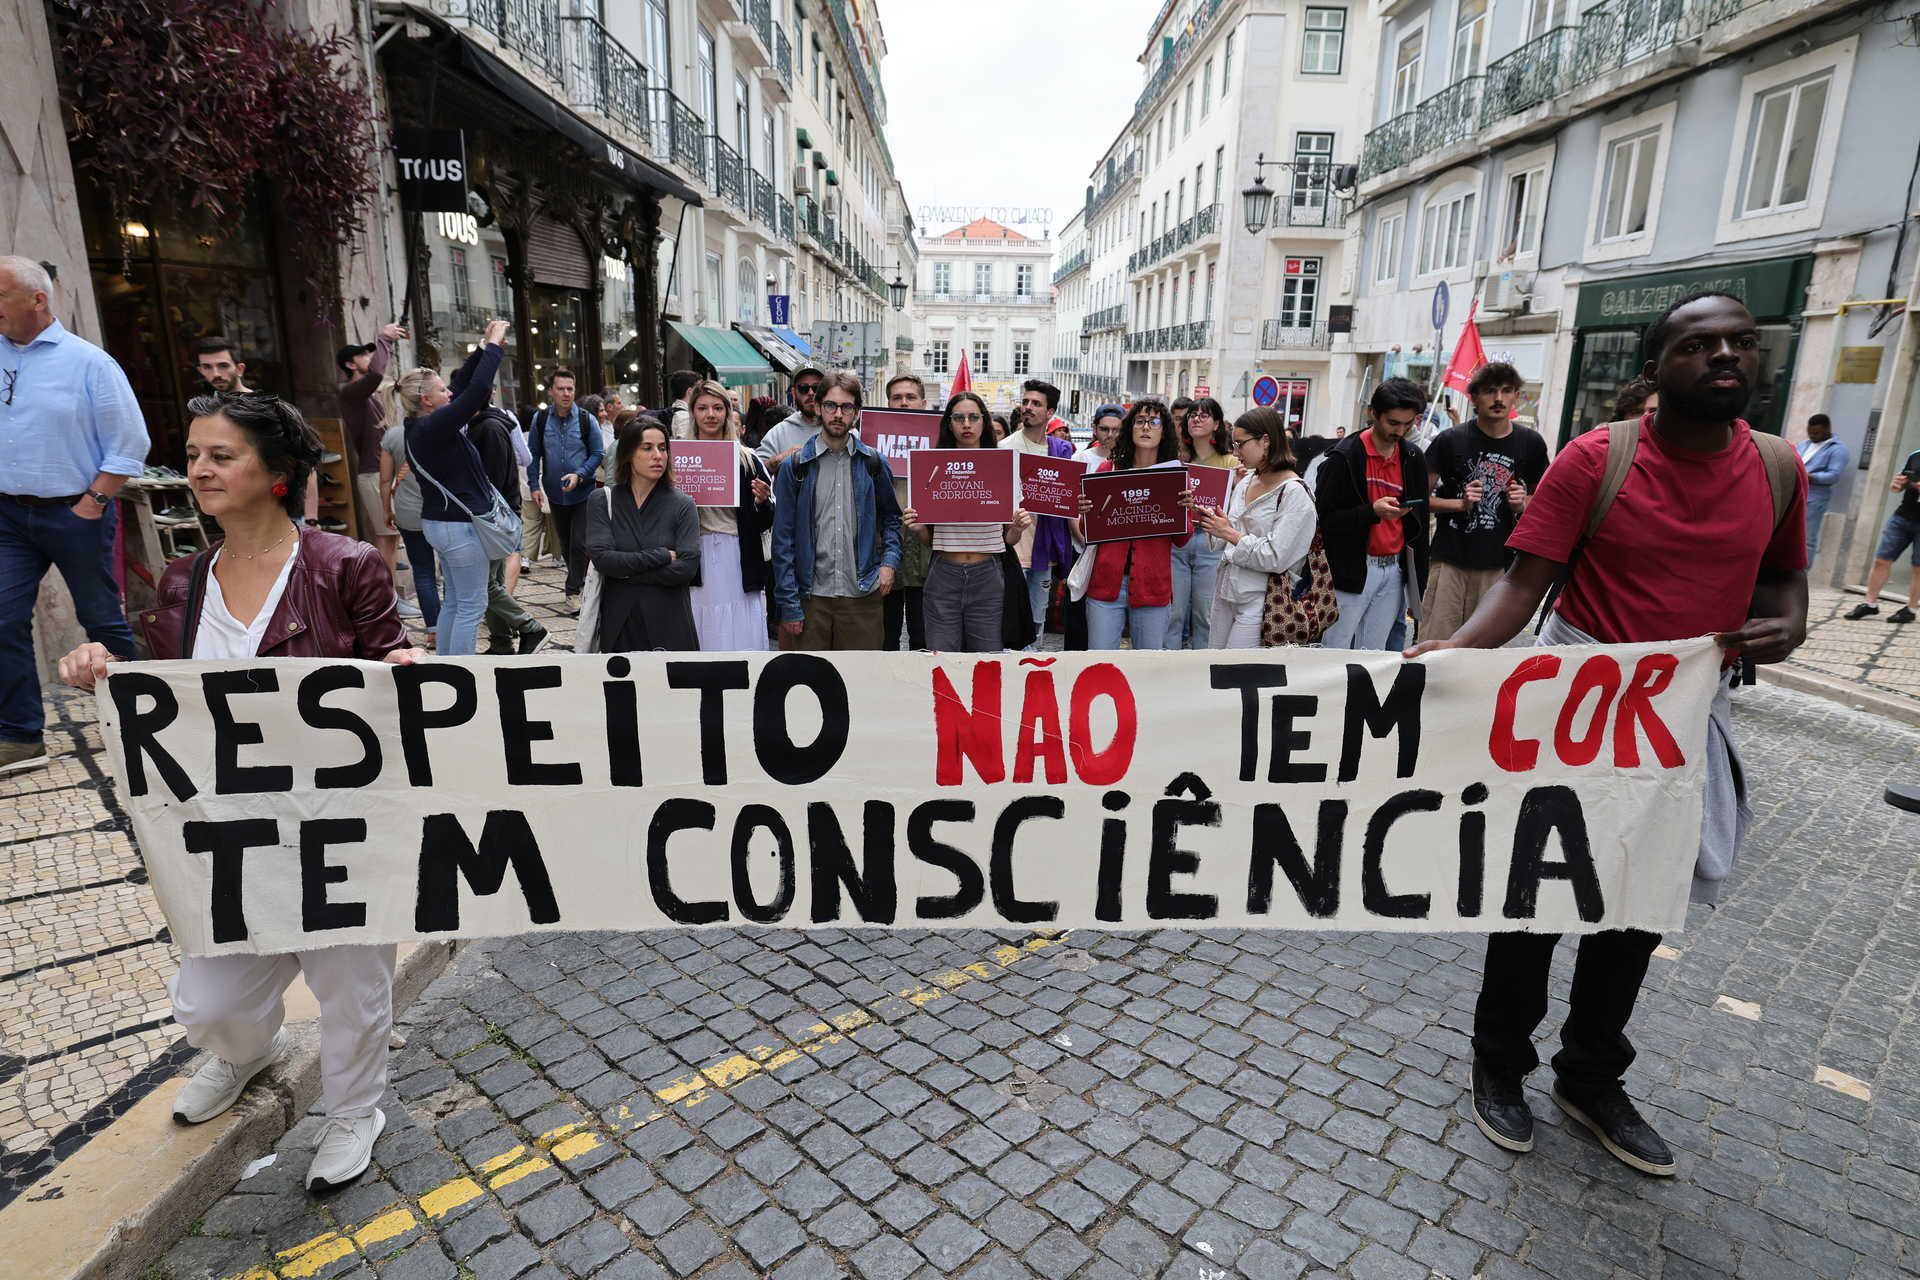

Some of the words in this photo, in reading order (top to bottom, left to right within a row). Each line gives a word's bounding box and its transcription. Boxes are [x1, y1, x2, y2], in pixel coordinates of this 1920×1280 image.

[400, 158, 463, 181] TOUS
[437, 212, 478, 246] TOUS
[604, 255, 626, 281] TOUS
[876, 433, 930, 459] MATA
[674, 456, 702, 464] 2010
[946, 462, 974, 471] 2019
[685, 475, 726, 484] BORGES
[1037, 468, 1060, 478] 2004
[940, 480, 984, 490] GIOVANI
[1022, 483, 1038, 493] OSÉ
[1040, 485, 1073, 497] CARLOS
[932, 490, 993, 500] RODRIGUES
[1027, 492, 1062, 504] VICENTE
[1121, 488, 1150, 498] 1995
[1193, 495, 1217, 505] ANDÉ
[1112, 503, 1161, 517] ALCINDO
[1107, 512, 1166, 527] MONTEIRO
[932, 657, 1137, 786] NÃO
[1210, 663, 1426, 784] TEM
[1489, 653, 1686, 773] COR
[183, 810, 560, 944] TEM
